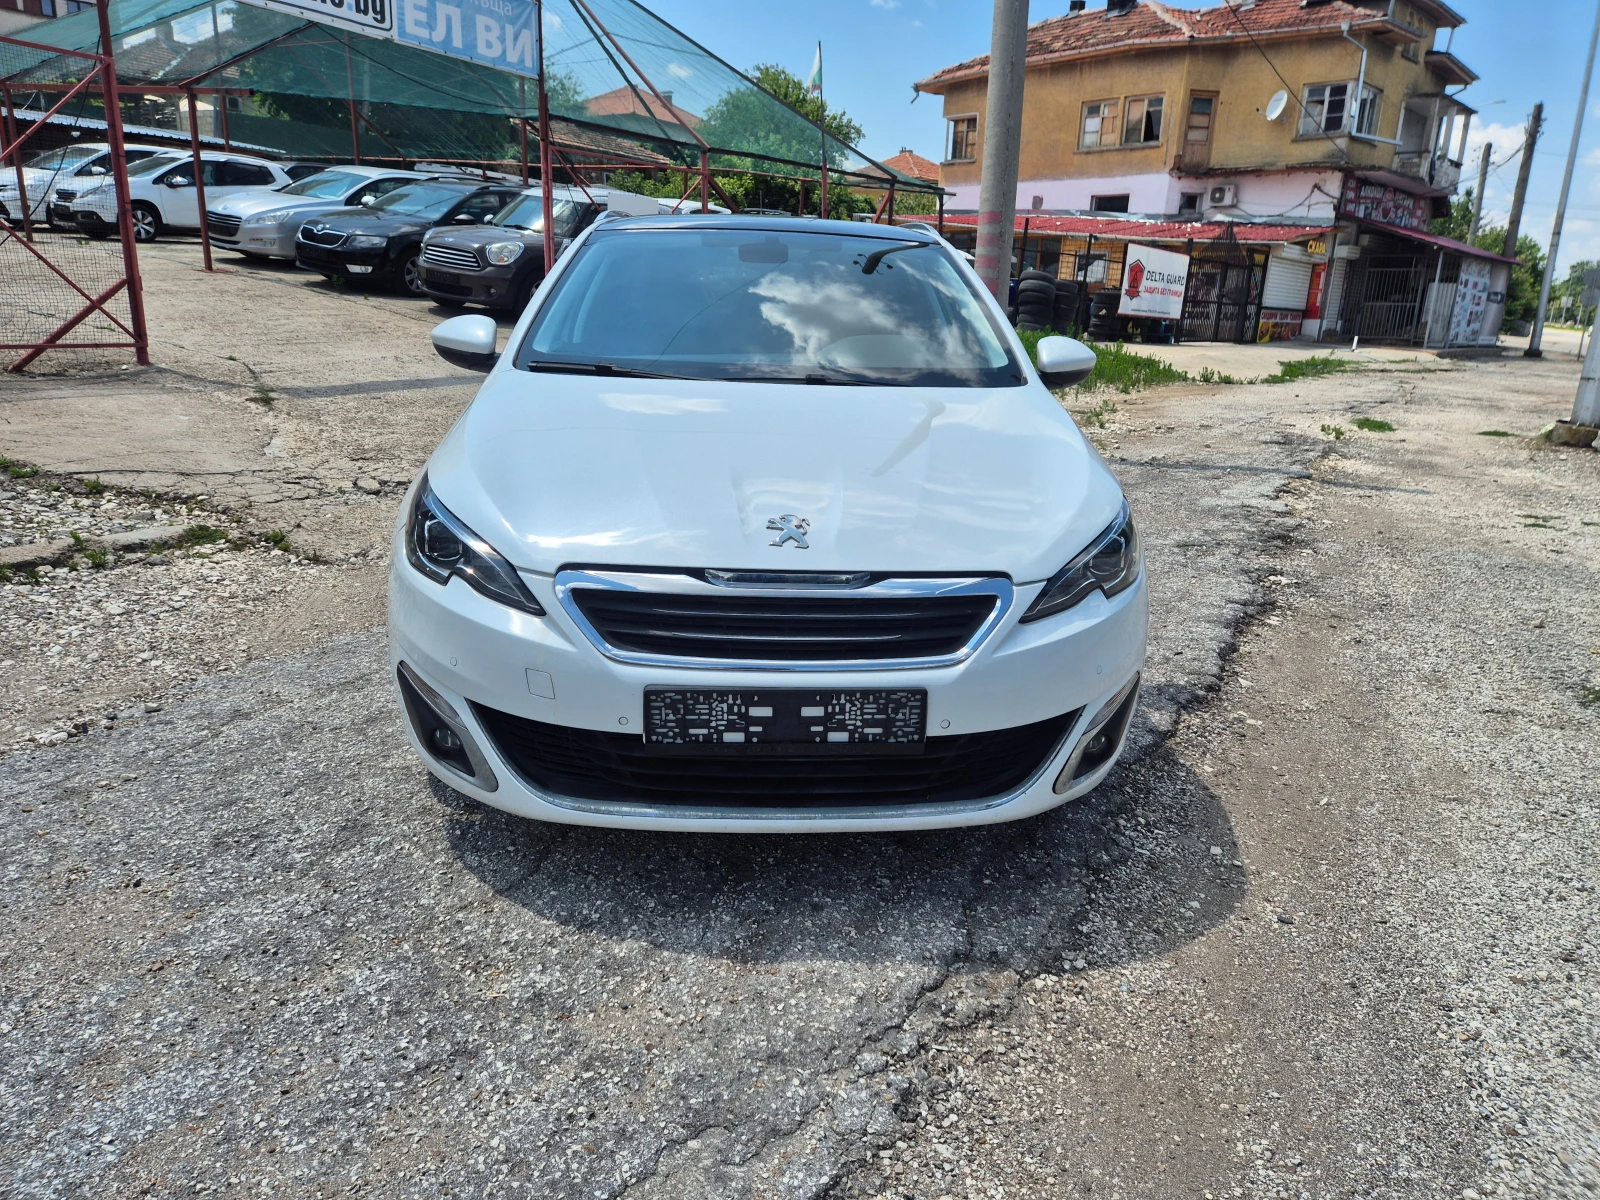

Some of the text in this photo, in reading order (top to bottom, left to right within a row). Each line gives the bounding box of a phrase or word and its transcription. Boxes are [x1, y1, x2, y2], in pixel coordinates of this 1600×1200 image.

[404, 0, 533, 69] ЕЛ ВИ
[1307, 240, 1326, 254] СКАРА
[1146, 270, 1185, 286] DELTA GUARD
